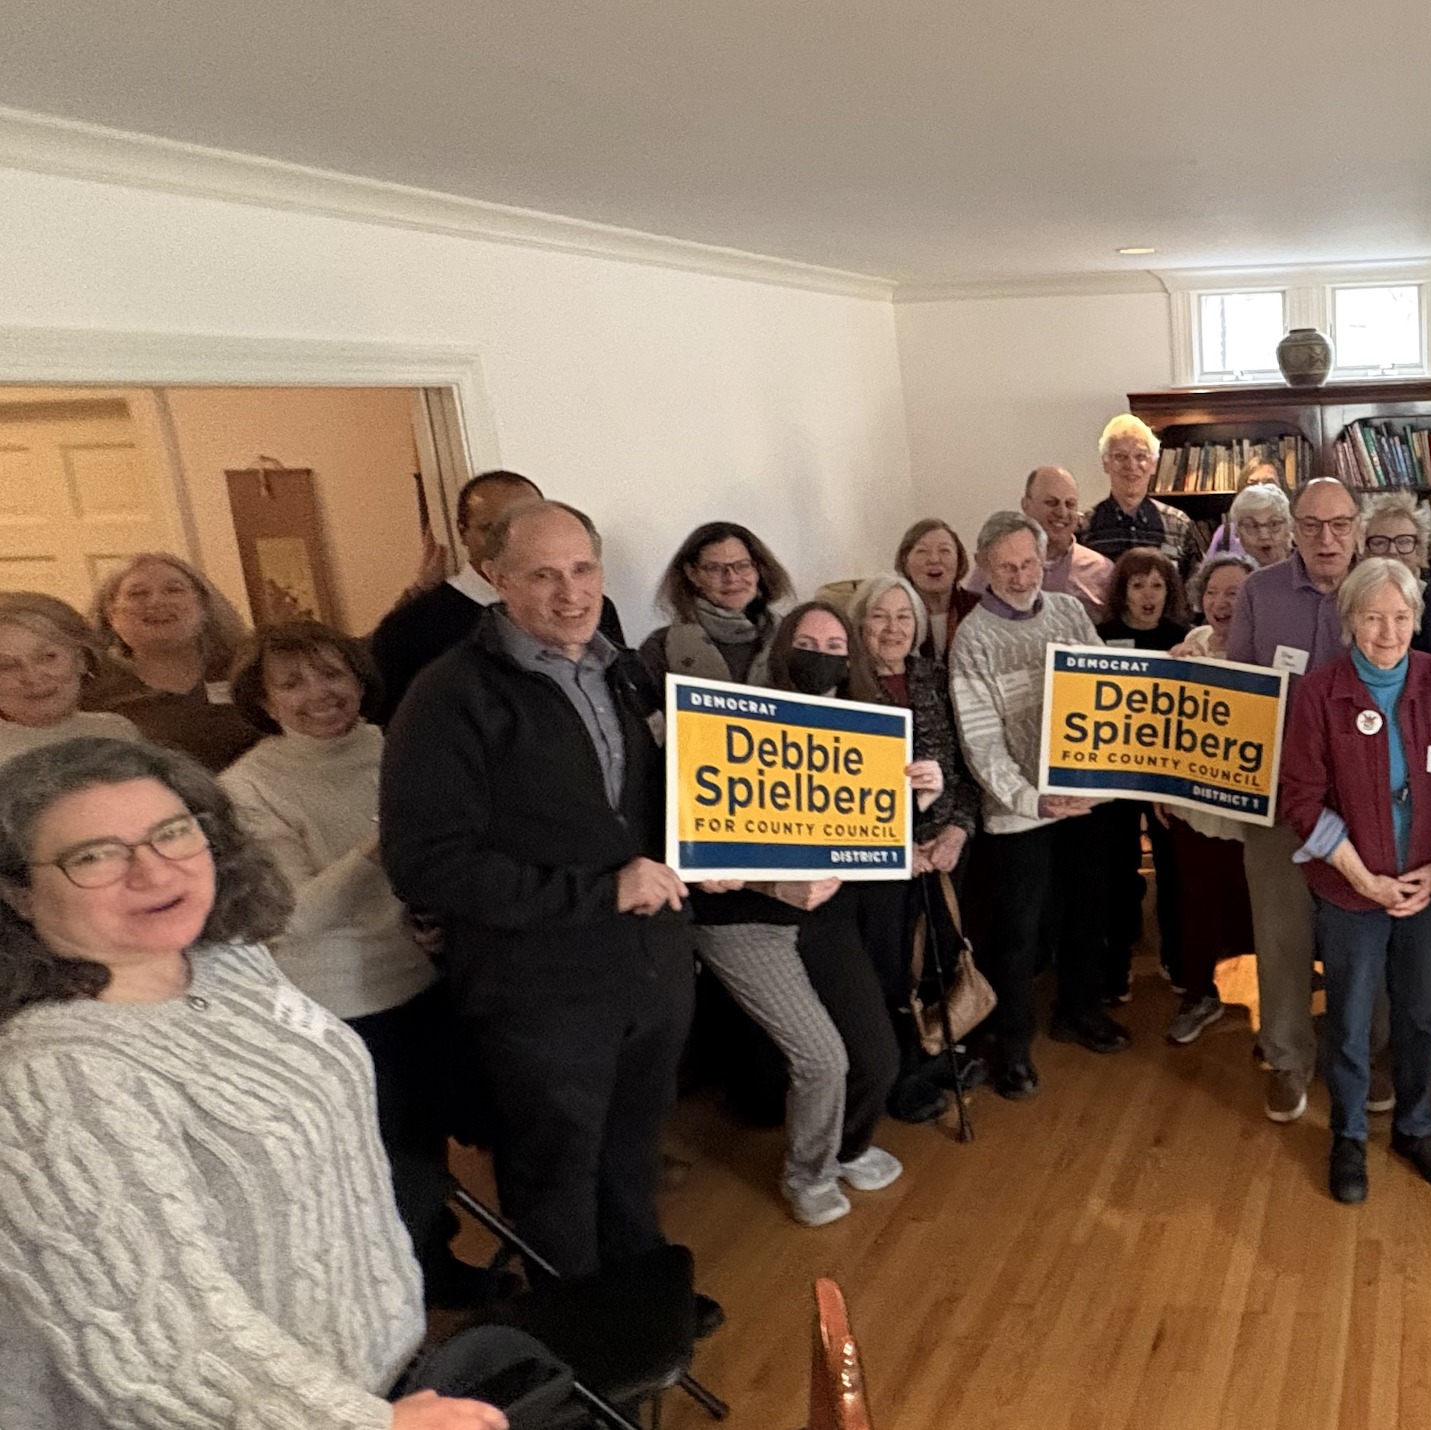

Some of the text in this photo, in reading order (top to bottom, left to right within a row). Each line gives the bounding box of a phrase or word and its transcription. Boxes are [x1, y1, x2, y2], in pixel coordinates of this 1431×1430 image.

[1066, 656, 1150, 672] DEMOCRAT
[690, 692, 778, 717] DEMOCRAT
[1094, 680, 1231, 726] Debbie
[725, 723, 864, 776] Debbie
[1063, 712, 1264, 773] Spielberg
[1061, 750, 1098, 763] FOR
[1107, 752, 1181, 771] COUNTY
[1188, 762, 1261, 787] COUNCIL
[694, 764, 897, 823] Spielberg
[1193, 785, 1260, 809] DISTRICT 1
[694, 817, 897, 838] FOR COUNTY COUNCIL
[830, 850, 898, 863] DISTRICT 1
